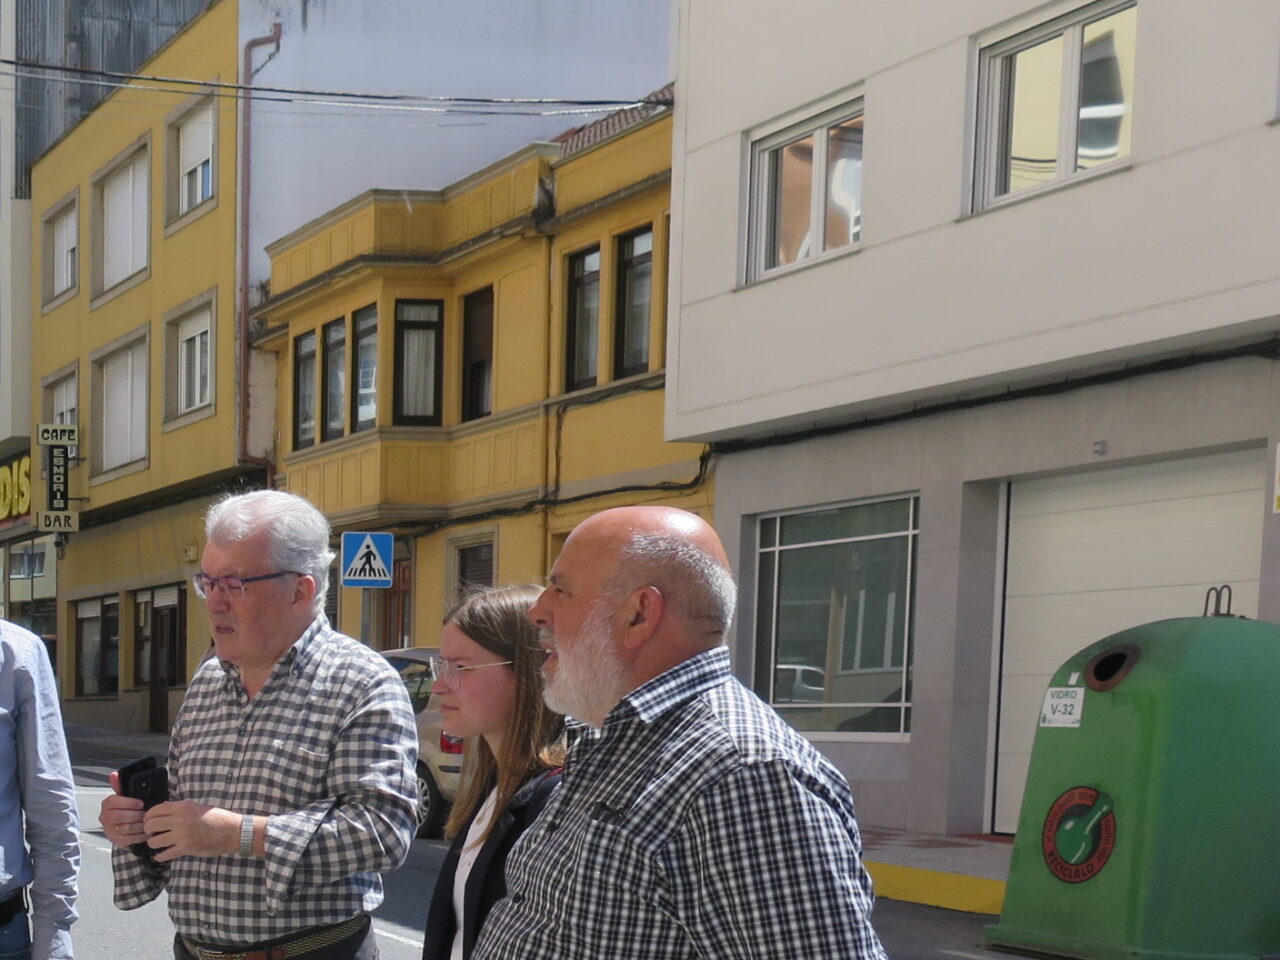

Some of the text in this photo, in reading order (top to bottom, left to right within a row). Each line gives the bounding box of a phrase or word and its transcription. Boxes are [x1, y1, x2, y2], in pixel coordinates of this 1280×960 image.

[41, 428, 76, 441] CAFE
[52, 448, 65, 508] ESMORIS
[44, 515, 72, 528] BAR
[1050, 690, 1078, 700] VIDRO
[1050, 703, 1075, 716] V-32
